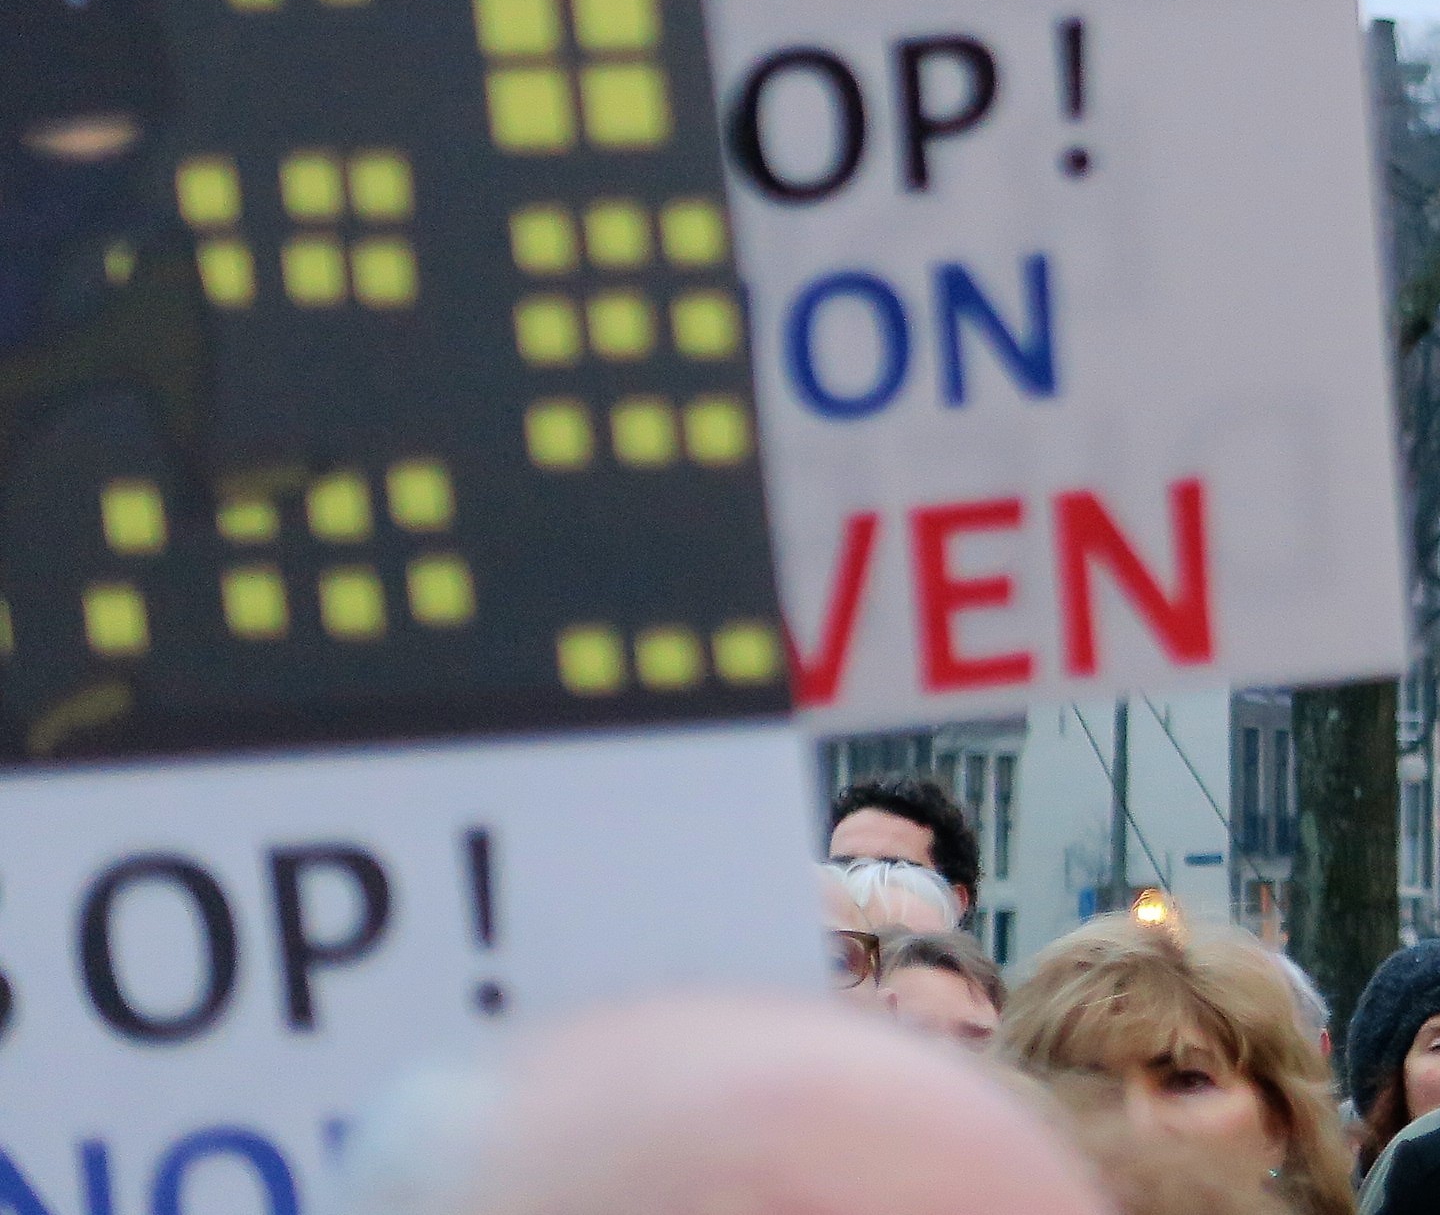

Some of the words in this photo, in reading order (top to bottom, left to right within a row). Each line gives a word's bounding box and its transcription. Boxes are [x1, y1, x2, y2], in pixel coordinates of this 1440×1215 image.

[728, 33, 999, 207] OP
[781, 251, 1060, 425] ON
[76, 841, 397, 1049] OP
